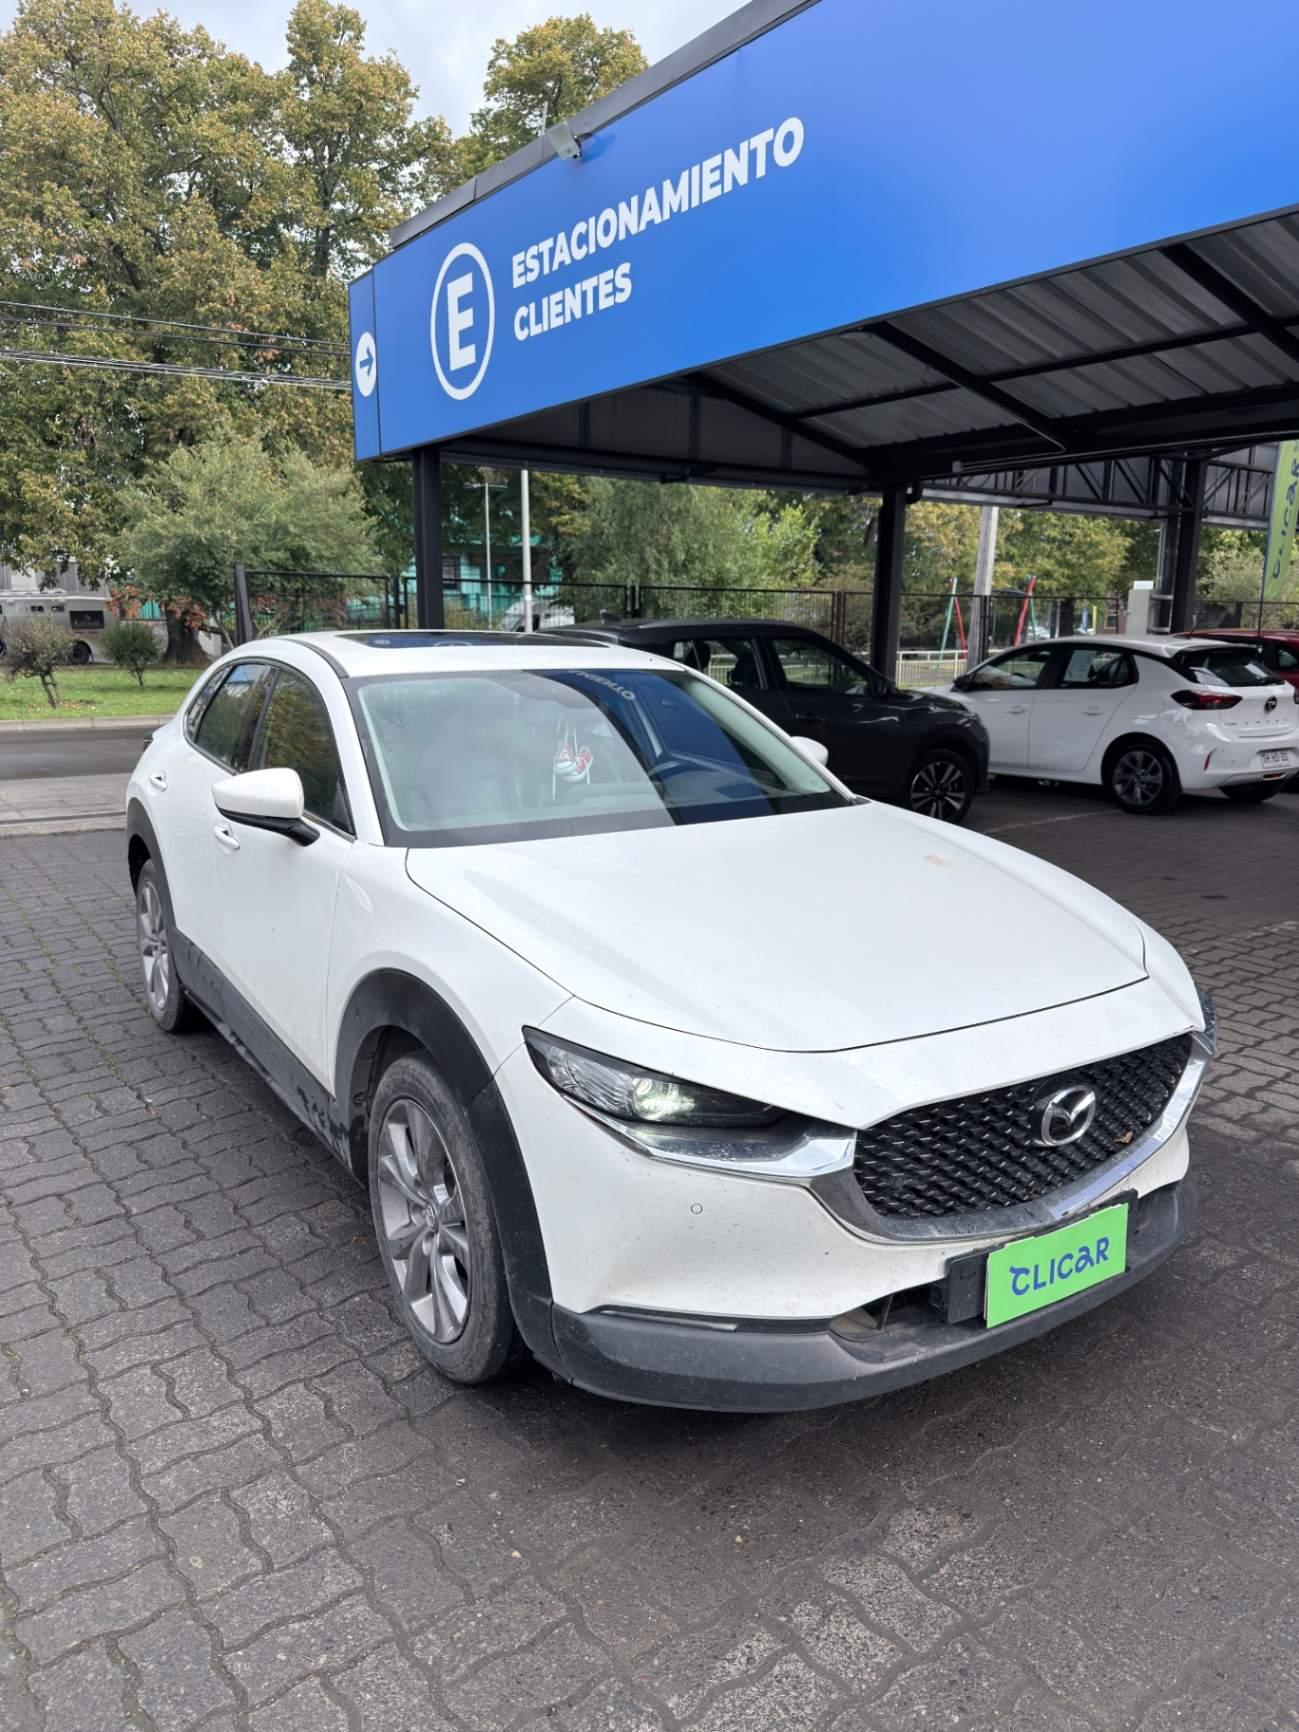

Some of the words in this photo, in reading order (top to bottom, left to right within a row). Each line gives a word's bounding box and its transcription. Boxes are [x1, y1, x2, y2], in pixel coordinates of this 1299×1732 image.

[512, 116, 805, 289] ESTACIONAMIENTO
[446, 272, 476, 371] E
[513, 262, 632, 341] CLIENTES
